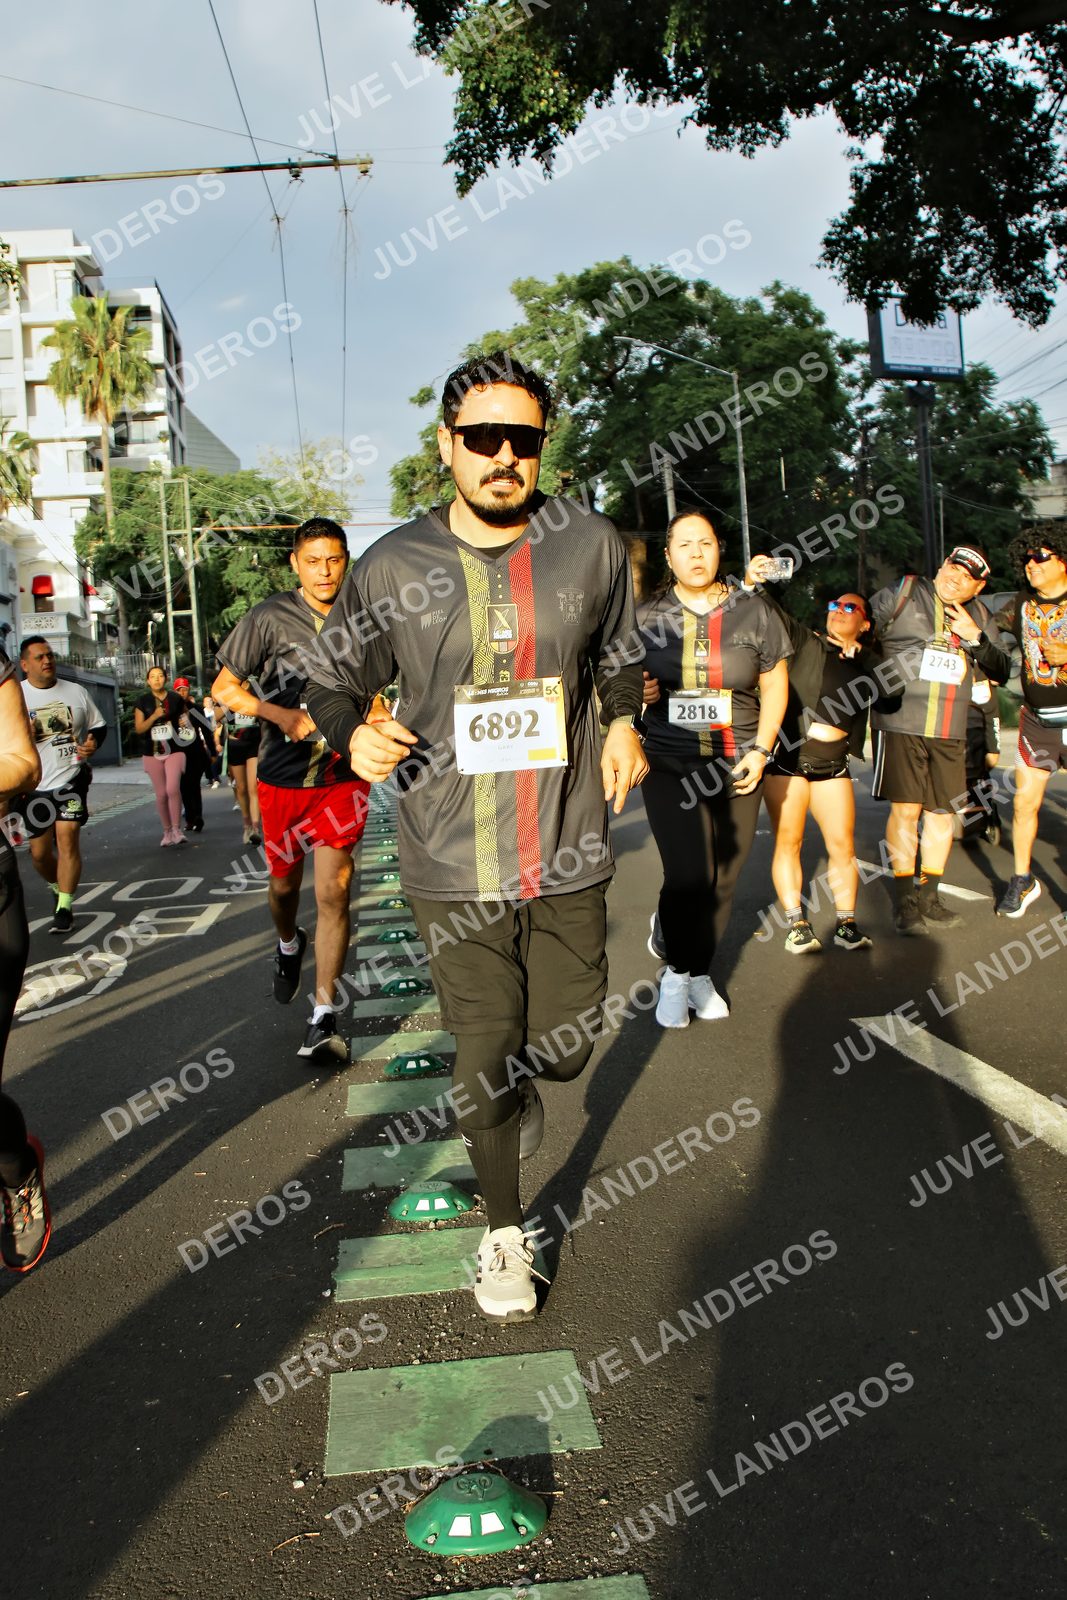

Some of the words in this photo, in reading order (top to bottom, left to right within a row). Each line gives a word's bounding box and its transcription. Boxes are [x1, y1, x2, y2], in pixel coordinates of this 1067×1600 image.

[928, 655, 957, 671] 2743
[545, 685, 560, 696] 5K
[677, 704, 718, 720] 2818
[469, 709, 540, 743] 6892
